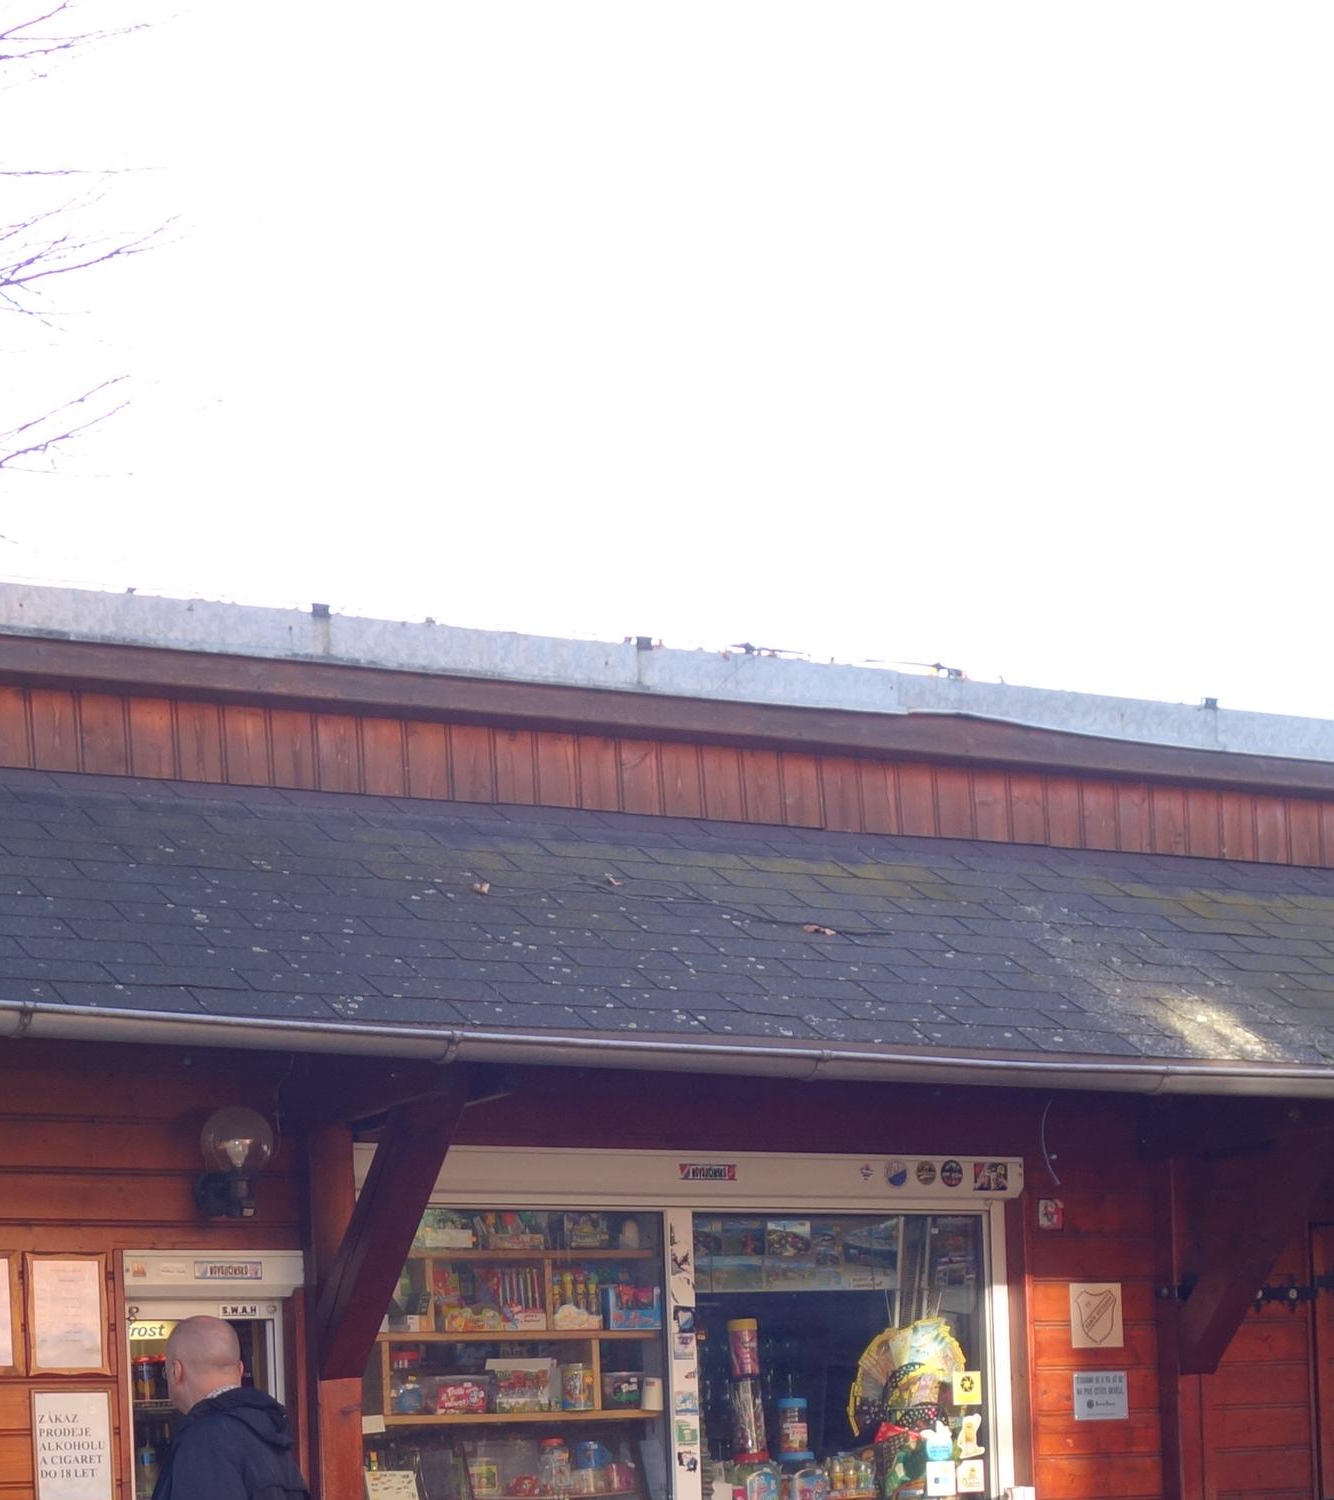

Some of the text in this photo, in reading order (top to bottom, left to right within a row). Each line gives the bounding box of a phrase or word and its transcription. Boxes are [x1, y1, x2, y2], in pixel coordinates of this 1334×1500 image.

[39, 1427, 91, 1437] PRODEJE
[40, 1440, 105, 1451] ALKOHOLU
[40, 1454, 103, 1465] A CIGARET
[40, 1467, 97, 1479] DO 18 LET
